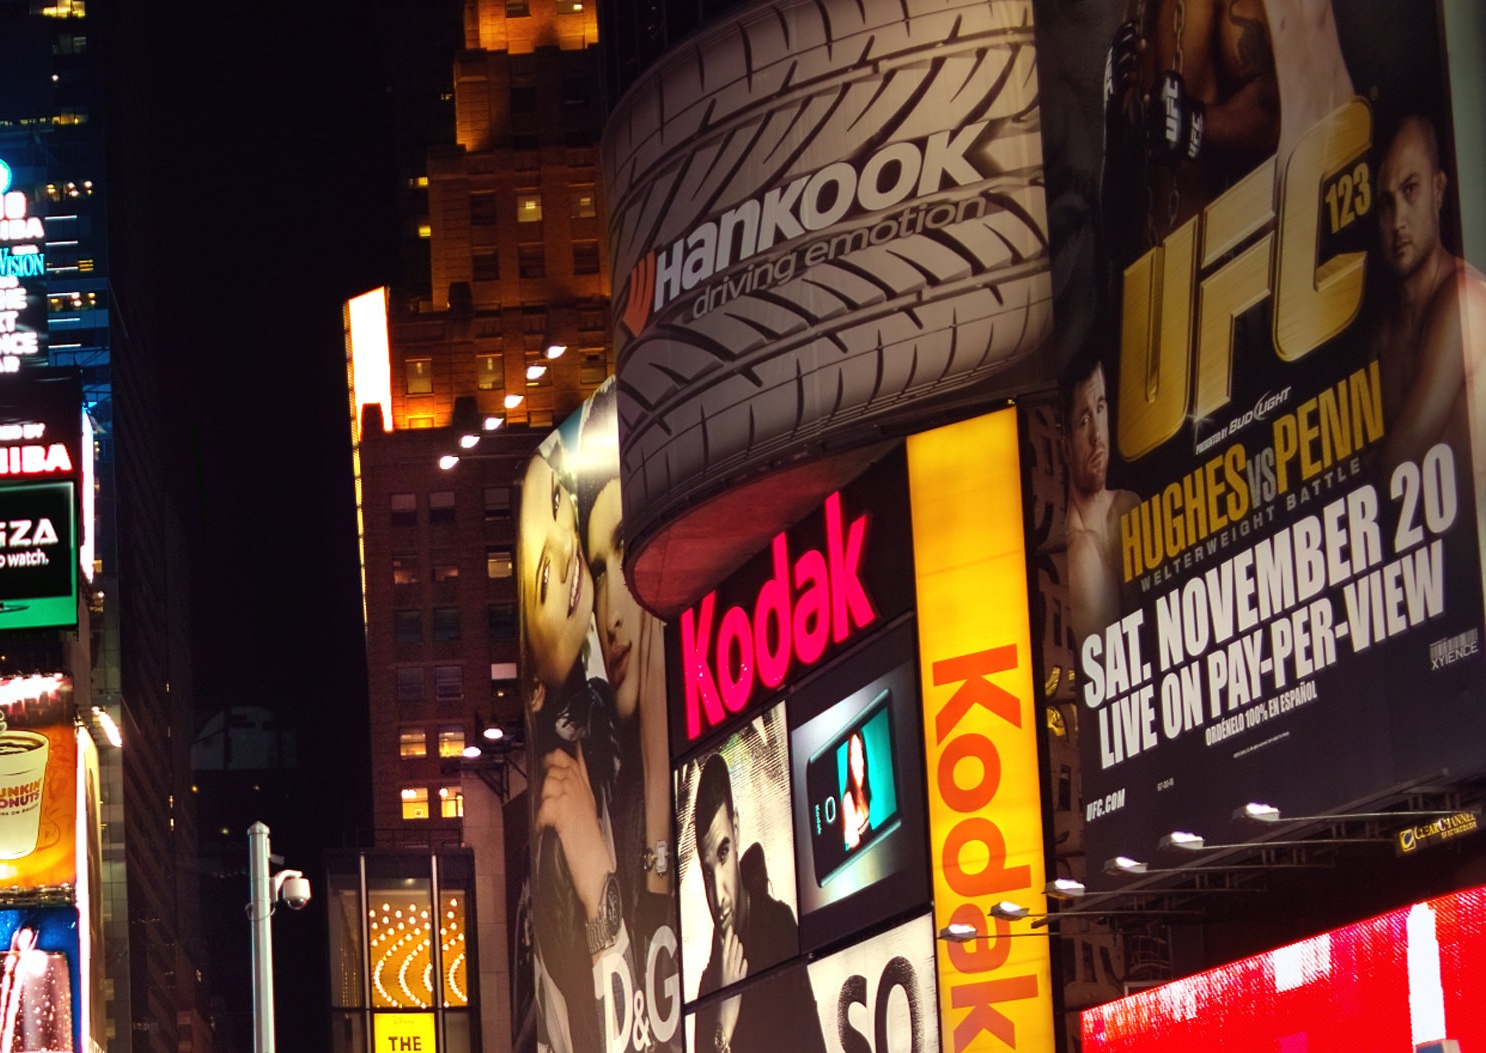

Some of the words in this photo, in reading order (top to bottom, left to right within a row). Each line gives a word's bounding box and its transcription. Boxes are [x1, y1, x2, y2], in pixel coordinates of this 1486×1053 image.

[692, 256, 796, 320] driving
[804, 197, 986, 268] emotion
[1118, 95, 1372, 461] UFC
[1324, 162, 1371, 234] 123
[1120, 443, 1248, 584] HUGHES
[1247, 447, 1275, 511] VS
[1272, 360, 1385, 494] PENN
[1140, 507, 1275, 593] WELTERWEIGHT
[1286, 458, 1360, 512] BATTLE
[680, 490, 879, 742] Kodak
[1081, 608, 1152, 709] SAT.
[1155, 482, 1383, 672] NOVEMBER
[1390, 442, 1459, 554] 20
[1099, 703, 1158, 770] LIVE
[1161, 661, 1203, 741] ON
[1207, 539, 1445, 720] PAY-PER-VIEW
[1085, 788, 1126, 822] UFC.COM
[388, 1036, 422, 1051] THE
